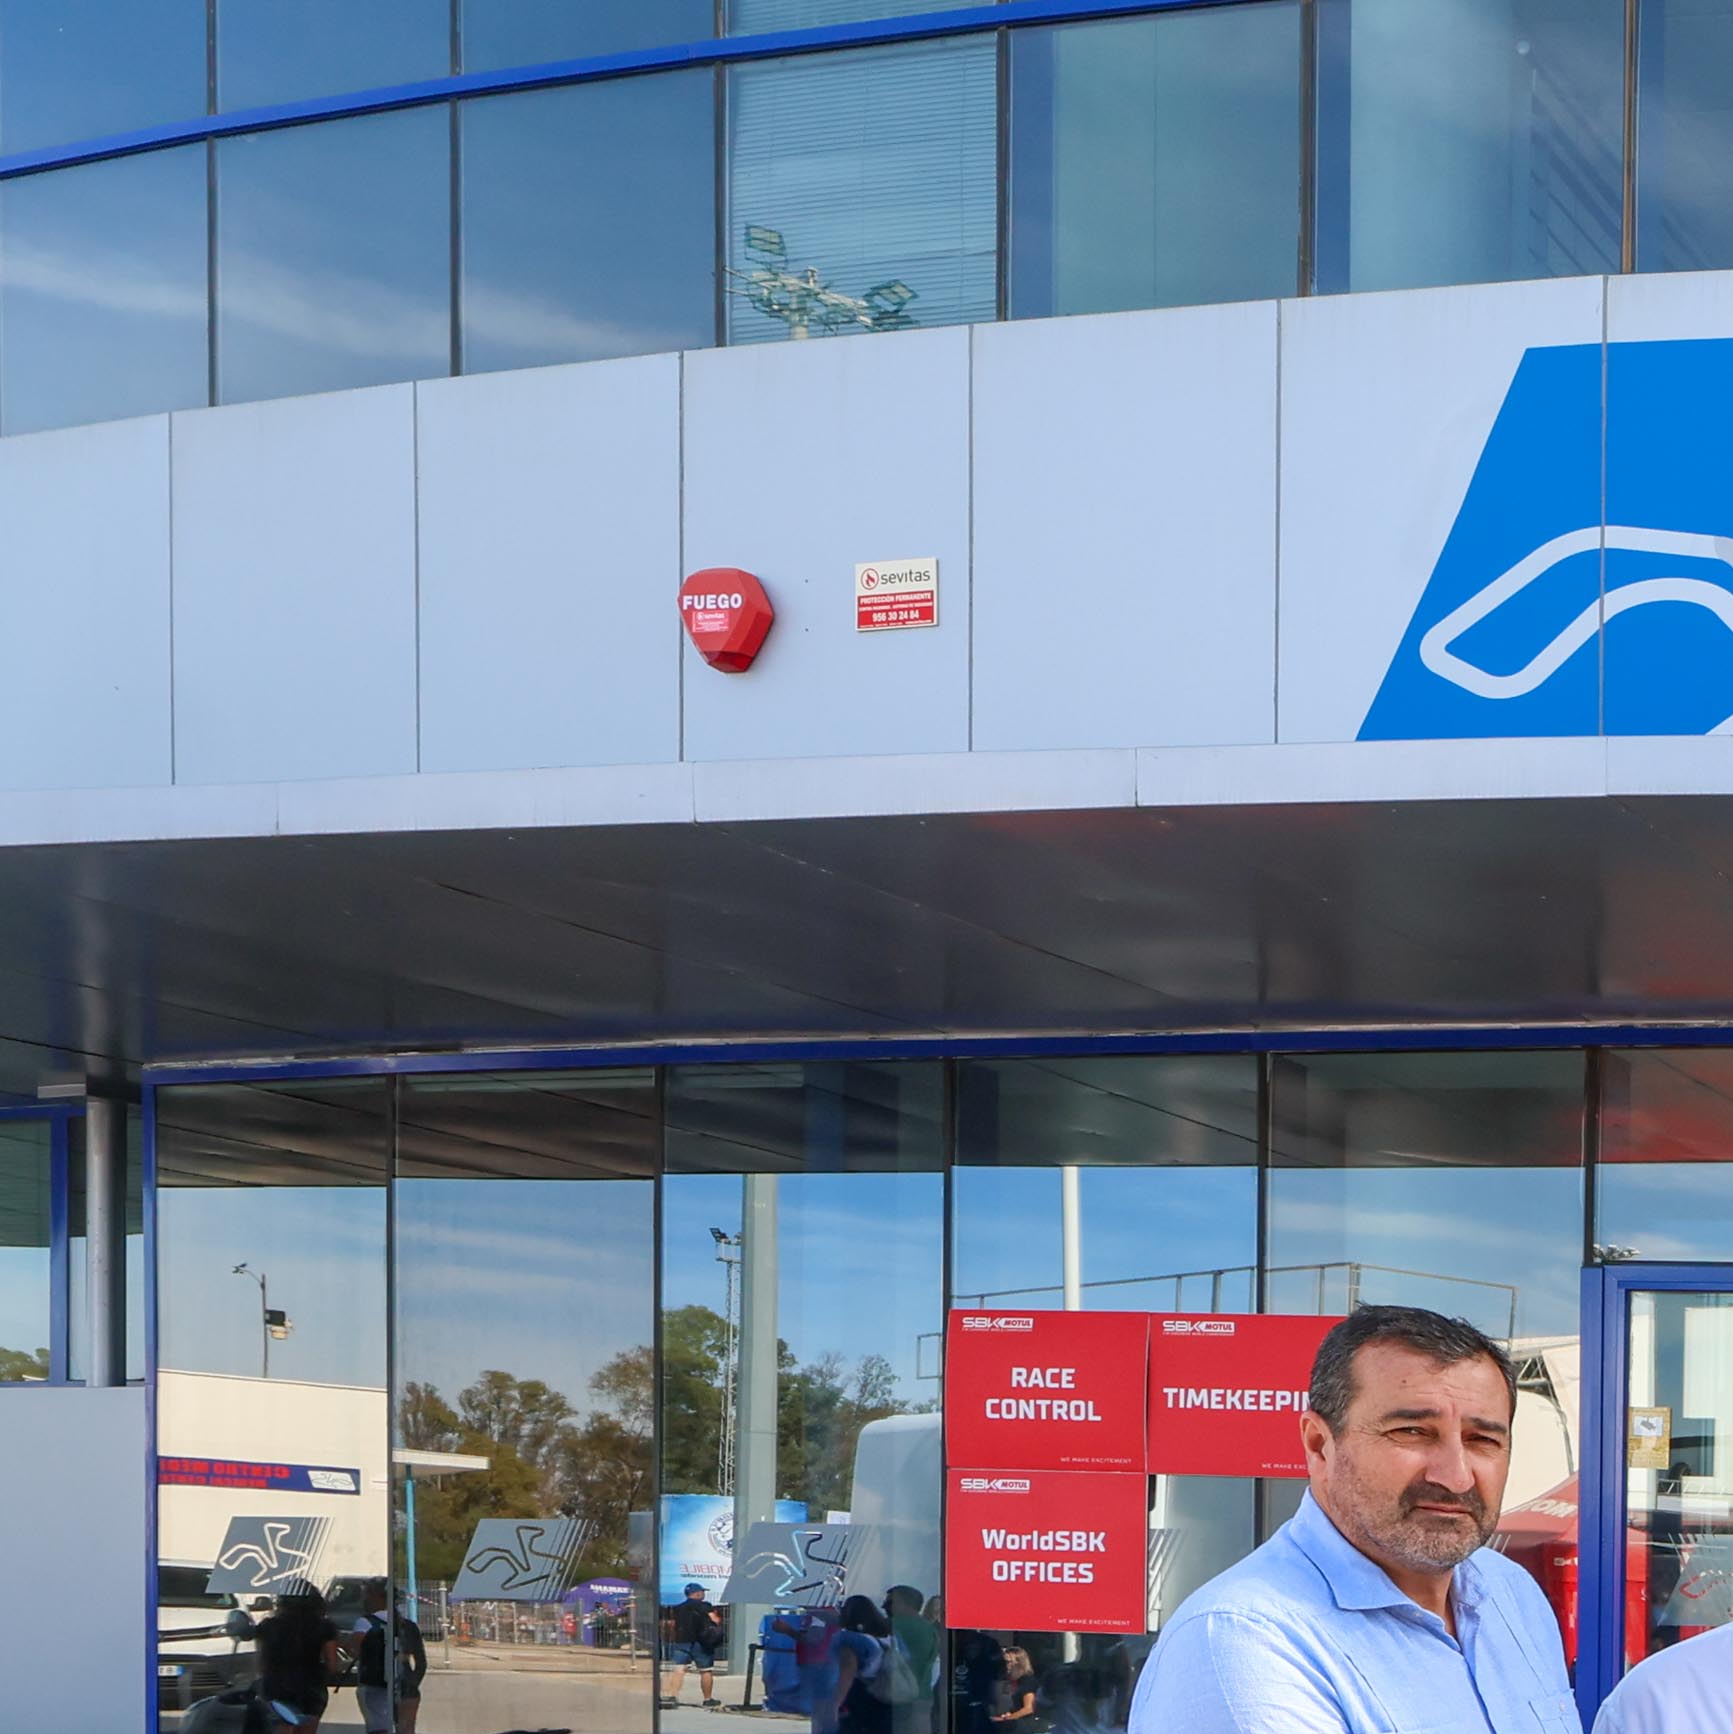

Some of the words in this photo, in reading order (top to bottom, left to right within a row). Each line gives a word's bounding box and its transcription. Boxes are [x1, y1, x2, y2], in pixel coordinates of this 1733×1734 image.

[880, 569, 931, 585] sevitas
[682, 592, 742, 610] FUEGO
[872, 612, 887, 623] 956
[962, 1317, 1001, 1328] SBK
[1162, 1320, 1201, 1332] SBK
[1204, 1323, 1233, 1331] MOTUL
[1011, 1367, 1076, 1388] RACE
[985, 1398, 1102, 1421] CONTROL
[960, 1478, 999, 1490] SBK
[1000, 1480, 1028, 1488] MOTUL
[981, 1529, 1106, 1552] WorldSBK
[992, 1560, 1094, 1584] OFFICES
